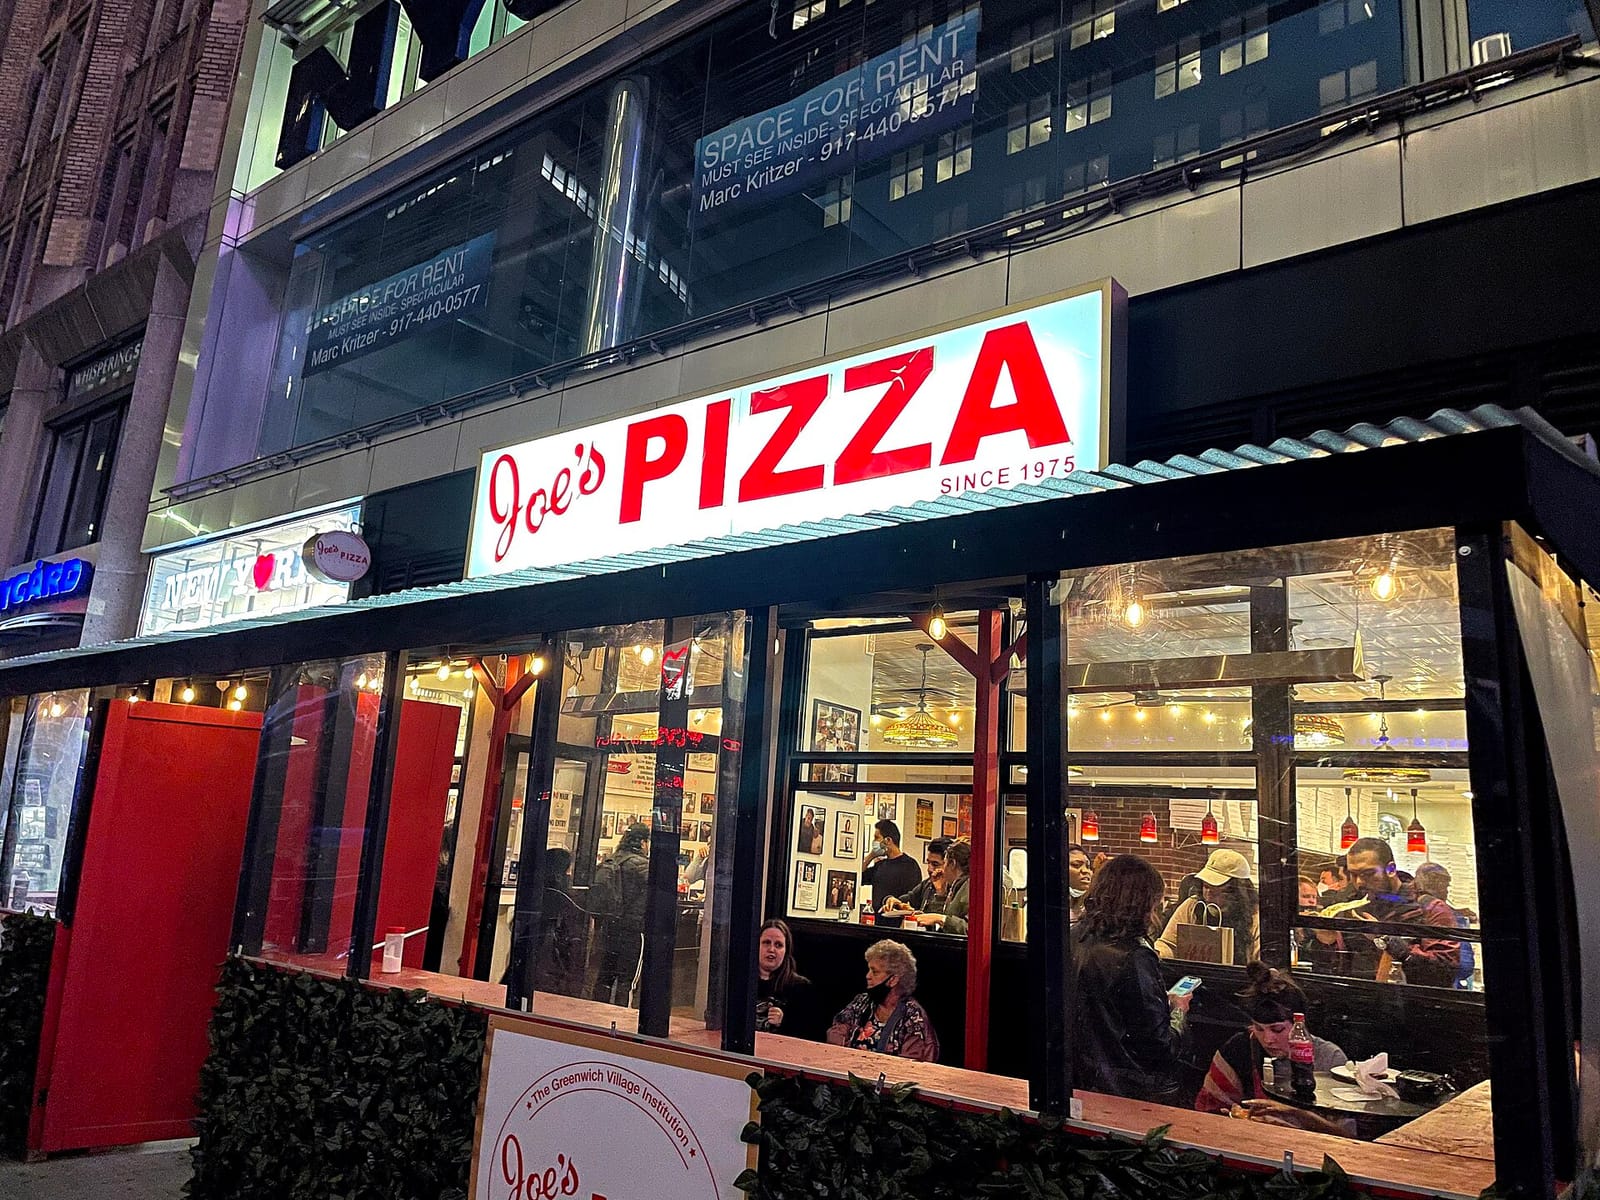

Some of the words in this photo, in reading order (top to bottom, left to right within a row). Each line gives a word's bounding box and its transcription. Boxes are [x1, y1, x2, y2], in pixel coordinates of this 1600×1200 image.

[702, 158, 741, 187] MUST
[744, 144, 772, 168] SEE
[838, 60, 964, 129] SPECTACULAR
[703, 108, 795, 169] SPACE
[803, 78, 865, 125] FOR
[875, 26, 966, 93] RENT
[700, 184, 740, 212] Marc
[746, 157, 801, 193] Kritzer
[820, 85, 962, 160] 917-4400577
[311, 346, 338, 367] Marc
[341, 328, 380, 355] Kritzer
[389, 285, 480, 336] 917-440-0577
[328, 324, 350, 339] MUST
[351, 316, 367, 330] SEE
[400, 273, 465, 309] SPECTACULAR
[331, 289, 382, 325] SPACE
[384, 273, 417, 302] FOR
[422, 249, 469, 287] RENT
[489, 441, 606, 563] Joe's
[618, 321, 1071, 525] PIZZA
[940, 467, 1010, 494] SINCE
[1019, 456, 1075, 480] 1975
[161, 564, 231, 610] NEW
[317, 540, 339, 556] Joe's
[341, 551, 368, 565] PIZZA
[531, 1086, 550, 1104] The
[551, 1068, 604, 1091] Greenwich
[606, 1070, 640, 1095] Village
[641, 1086, 689, 1148] Institution
[502, 1134, 579, 1200] Joe's
